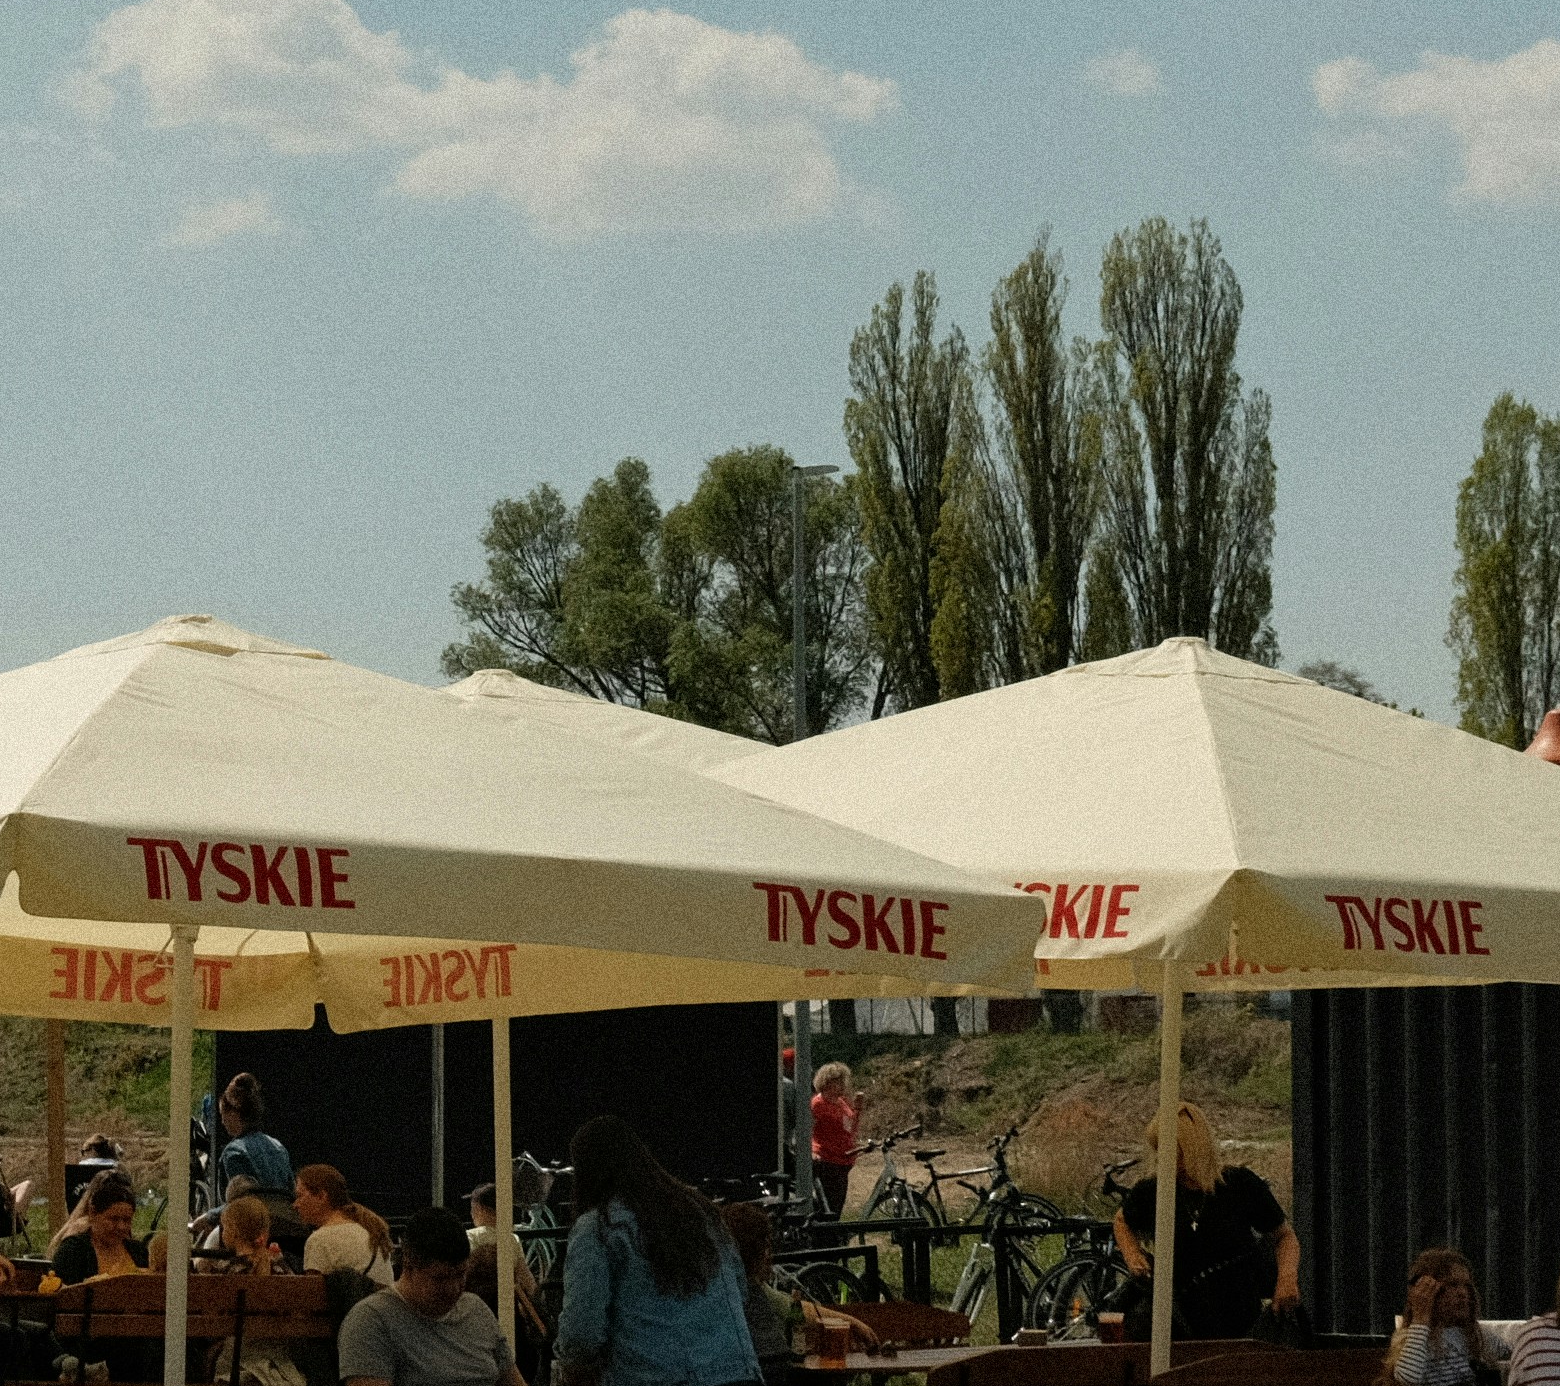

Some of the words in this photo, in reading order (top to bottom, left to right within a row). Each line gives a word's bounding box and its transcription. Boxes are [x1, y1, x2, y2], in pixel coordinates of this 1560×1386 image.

[126, 836, 355, 910] TYSKIE
[753, 882, 949, 960] TYSKIE
[1325, 894, 1490, 956] TYSKIE
